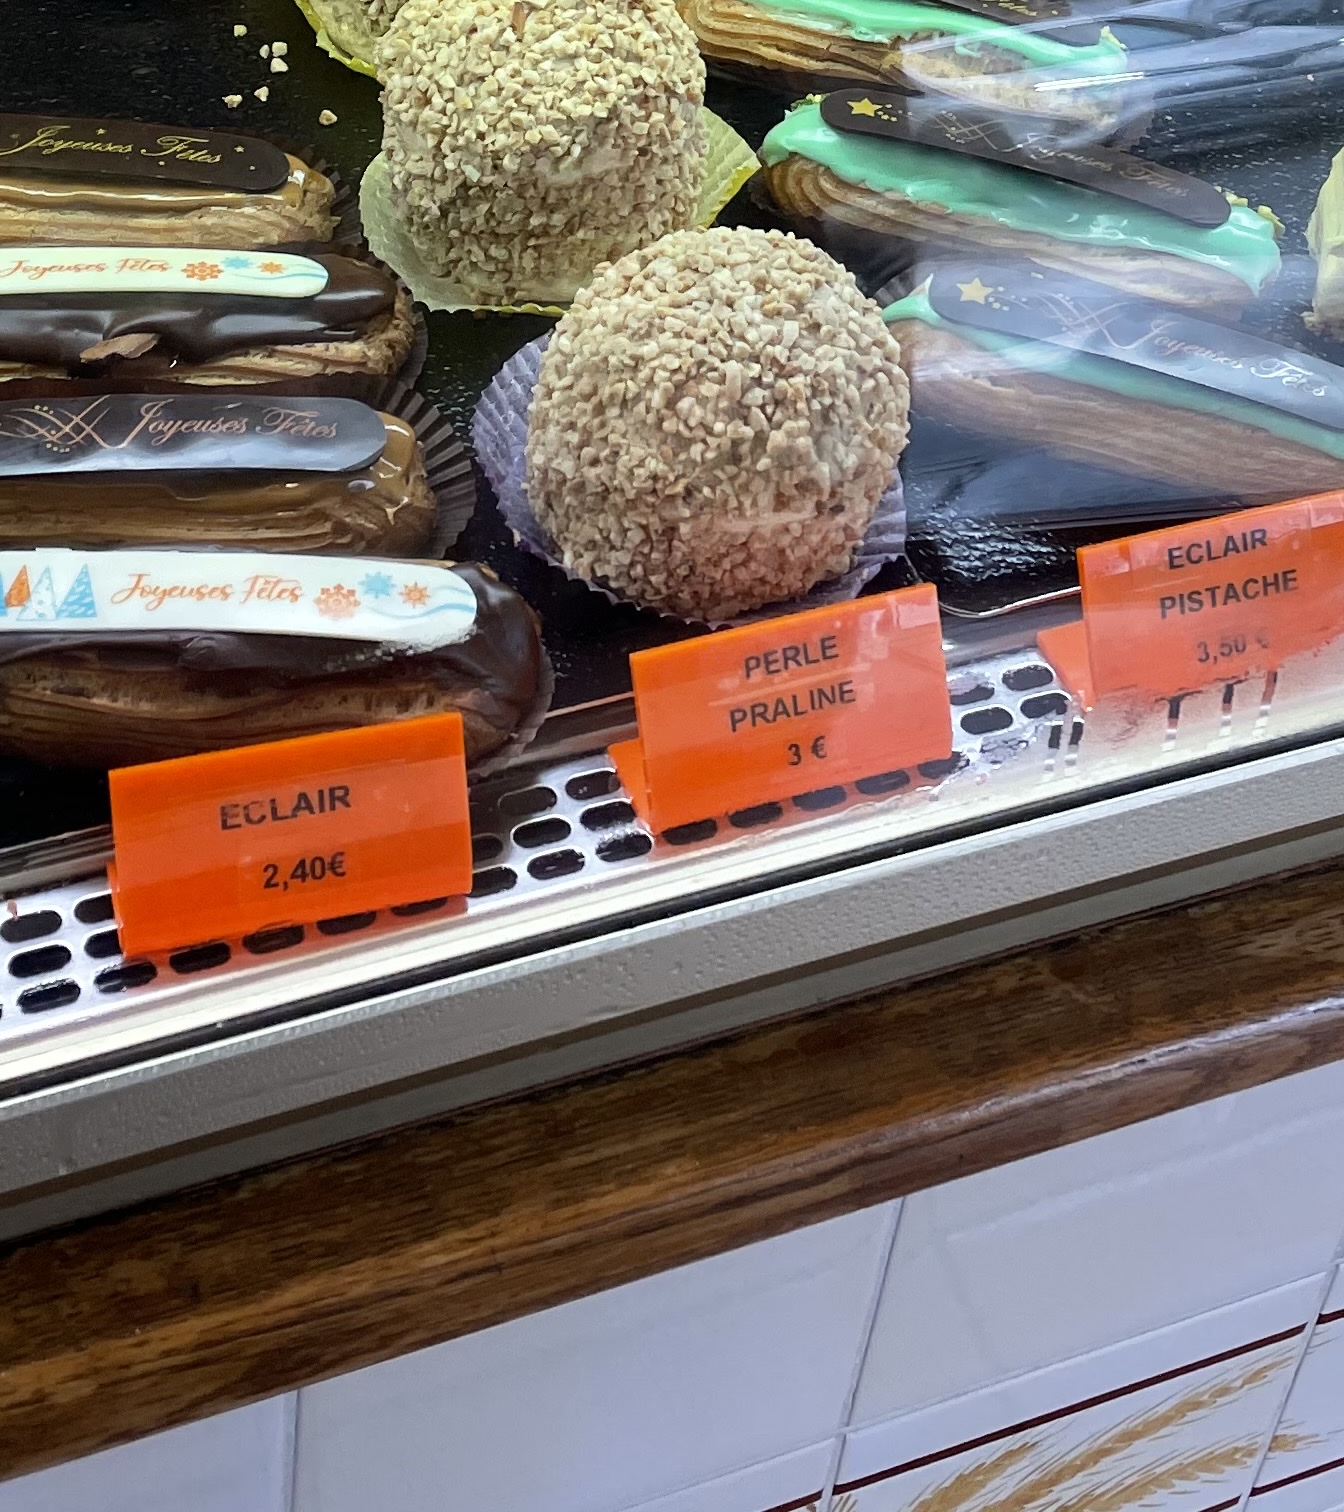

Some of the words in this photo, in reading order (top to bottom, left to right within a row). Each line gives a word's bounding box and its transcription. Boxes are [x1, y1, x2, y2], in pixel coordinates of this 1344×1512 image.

[12, 125, 134, 155] Joyeuses
[120, 399, 249, 447] Joyeuses
[256, 406, 337, 438] Fêtes
[1167, 528, 1268, 571] ECLAIR
[110, 573, 235, 611] Joyeuses
[239, 574, 305, 604] Fêtes
[1159, 568, 1299, 619] PISTACHE
[744, 634, 840, 680] PERLE
[729, 679, 857, 733] PRALINE
[787, 742, 803, 766] 3
[811, 735, 828, 759] €
[219, 784, 353, 831] ECLAIR
[262, 851, 348, 892] 2,40€
